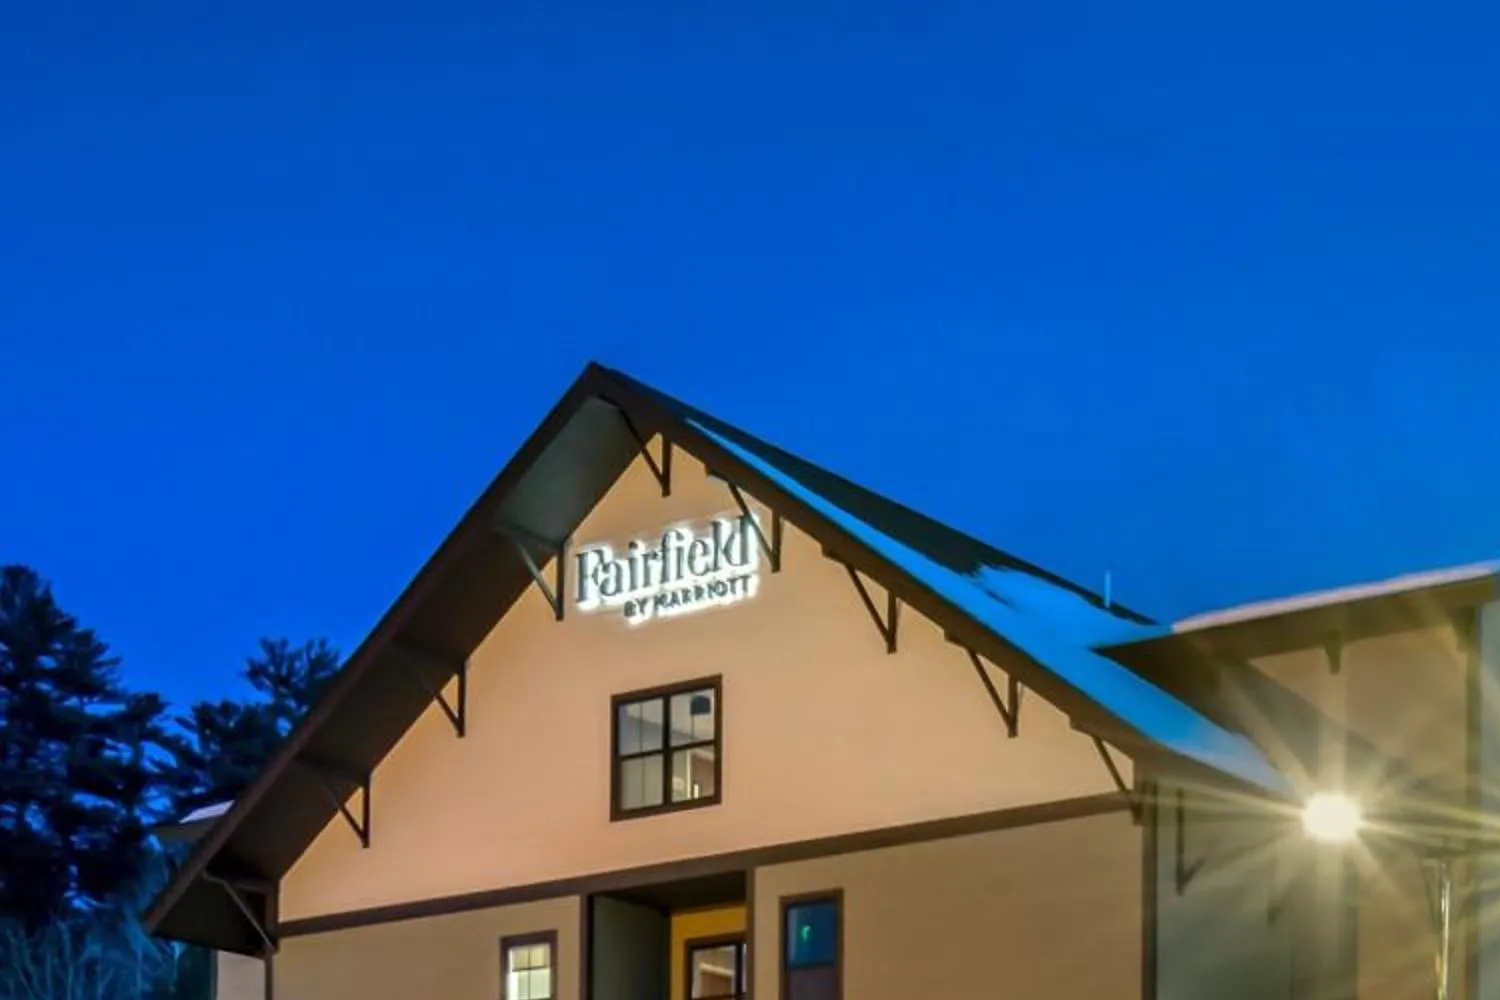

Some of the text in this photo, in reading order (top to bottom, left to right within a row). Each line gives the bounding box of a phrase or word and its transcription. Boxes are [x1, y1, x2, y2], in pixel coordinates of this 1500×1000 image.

[575, 514, 755, 604] Fairfield
[624, 575, 752, 617] BY MARRIOTT
